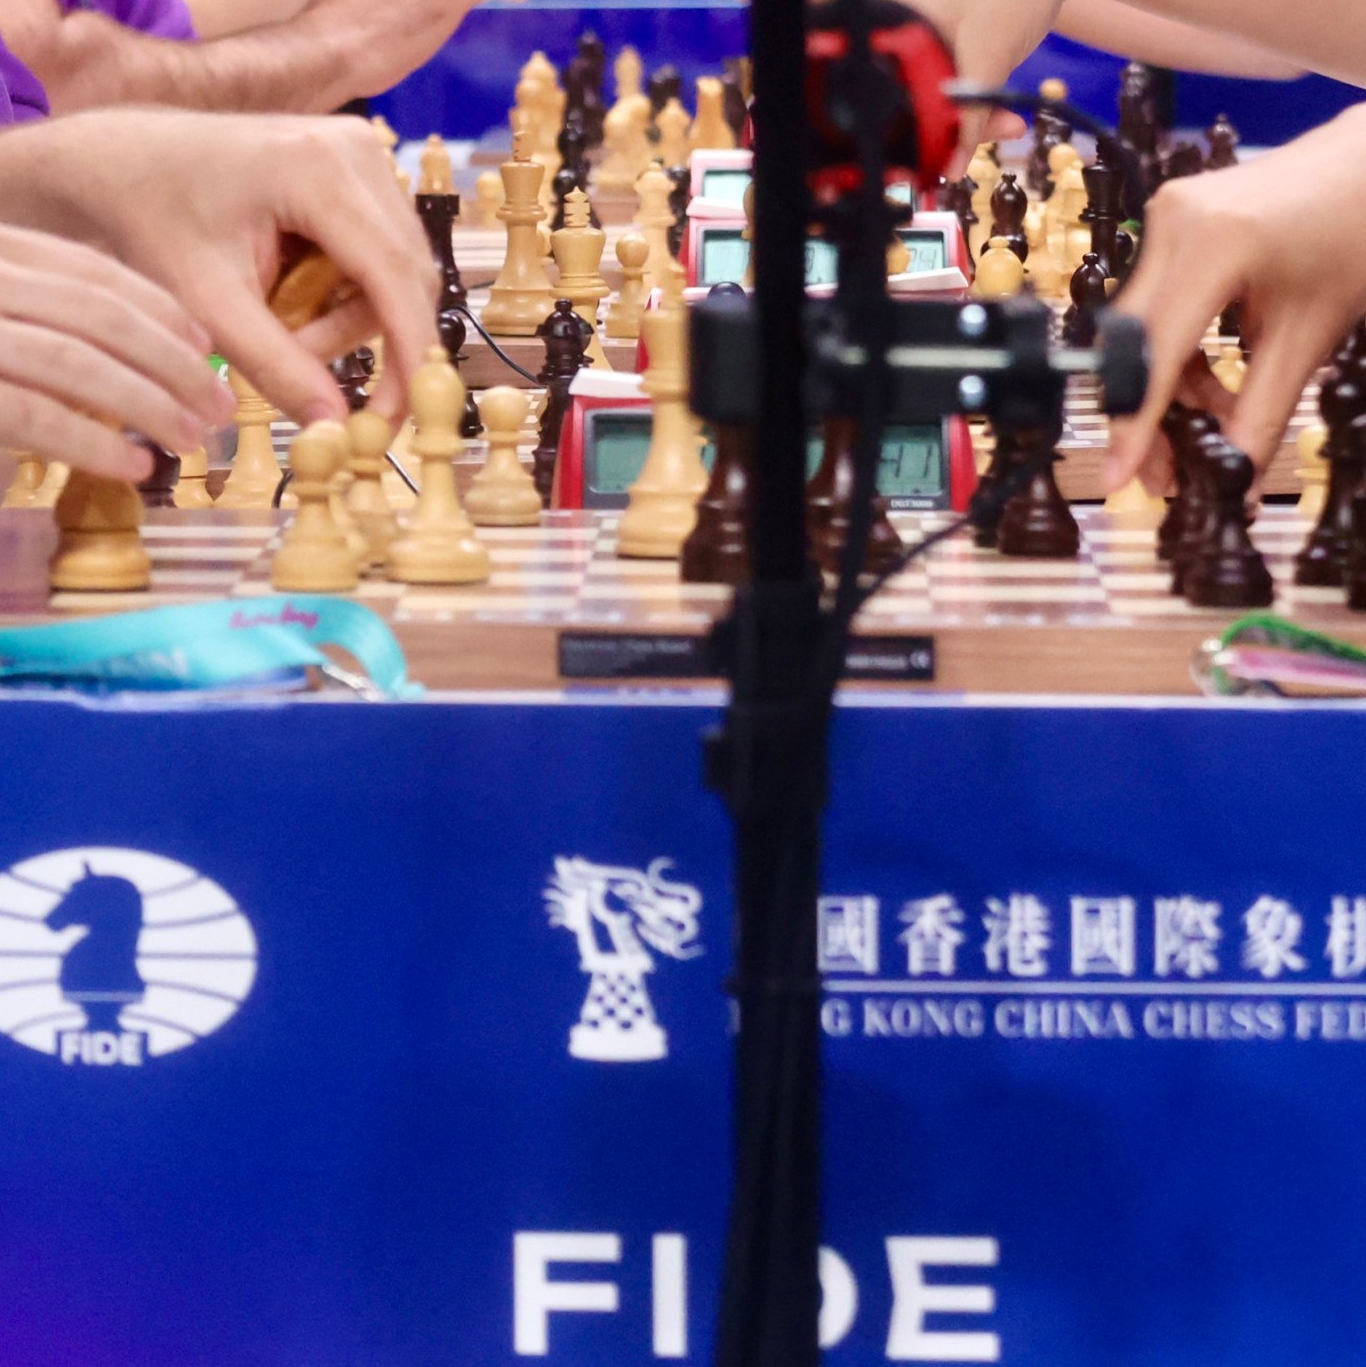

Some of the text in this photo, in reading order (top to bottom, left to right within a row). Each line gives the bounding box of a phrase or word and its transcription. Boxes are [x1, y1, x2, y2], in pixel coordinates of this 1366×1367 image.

[864, 999, 983, 1036] KONG
[994, 1000, 1134, 1038] CHINA
[1143, 1001, 1284, 1039] CHESS
[61, 1031, 143, 1066] FIDE
